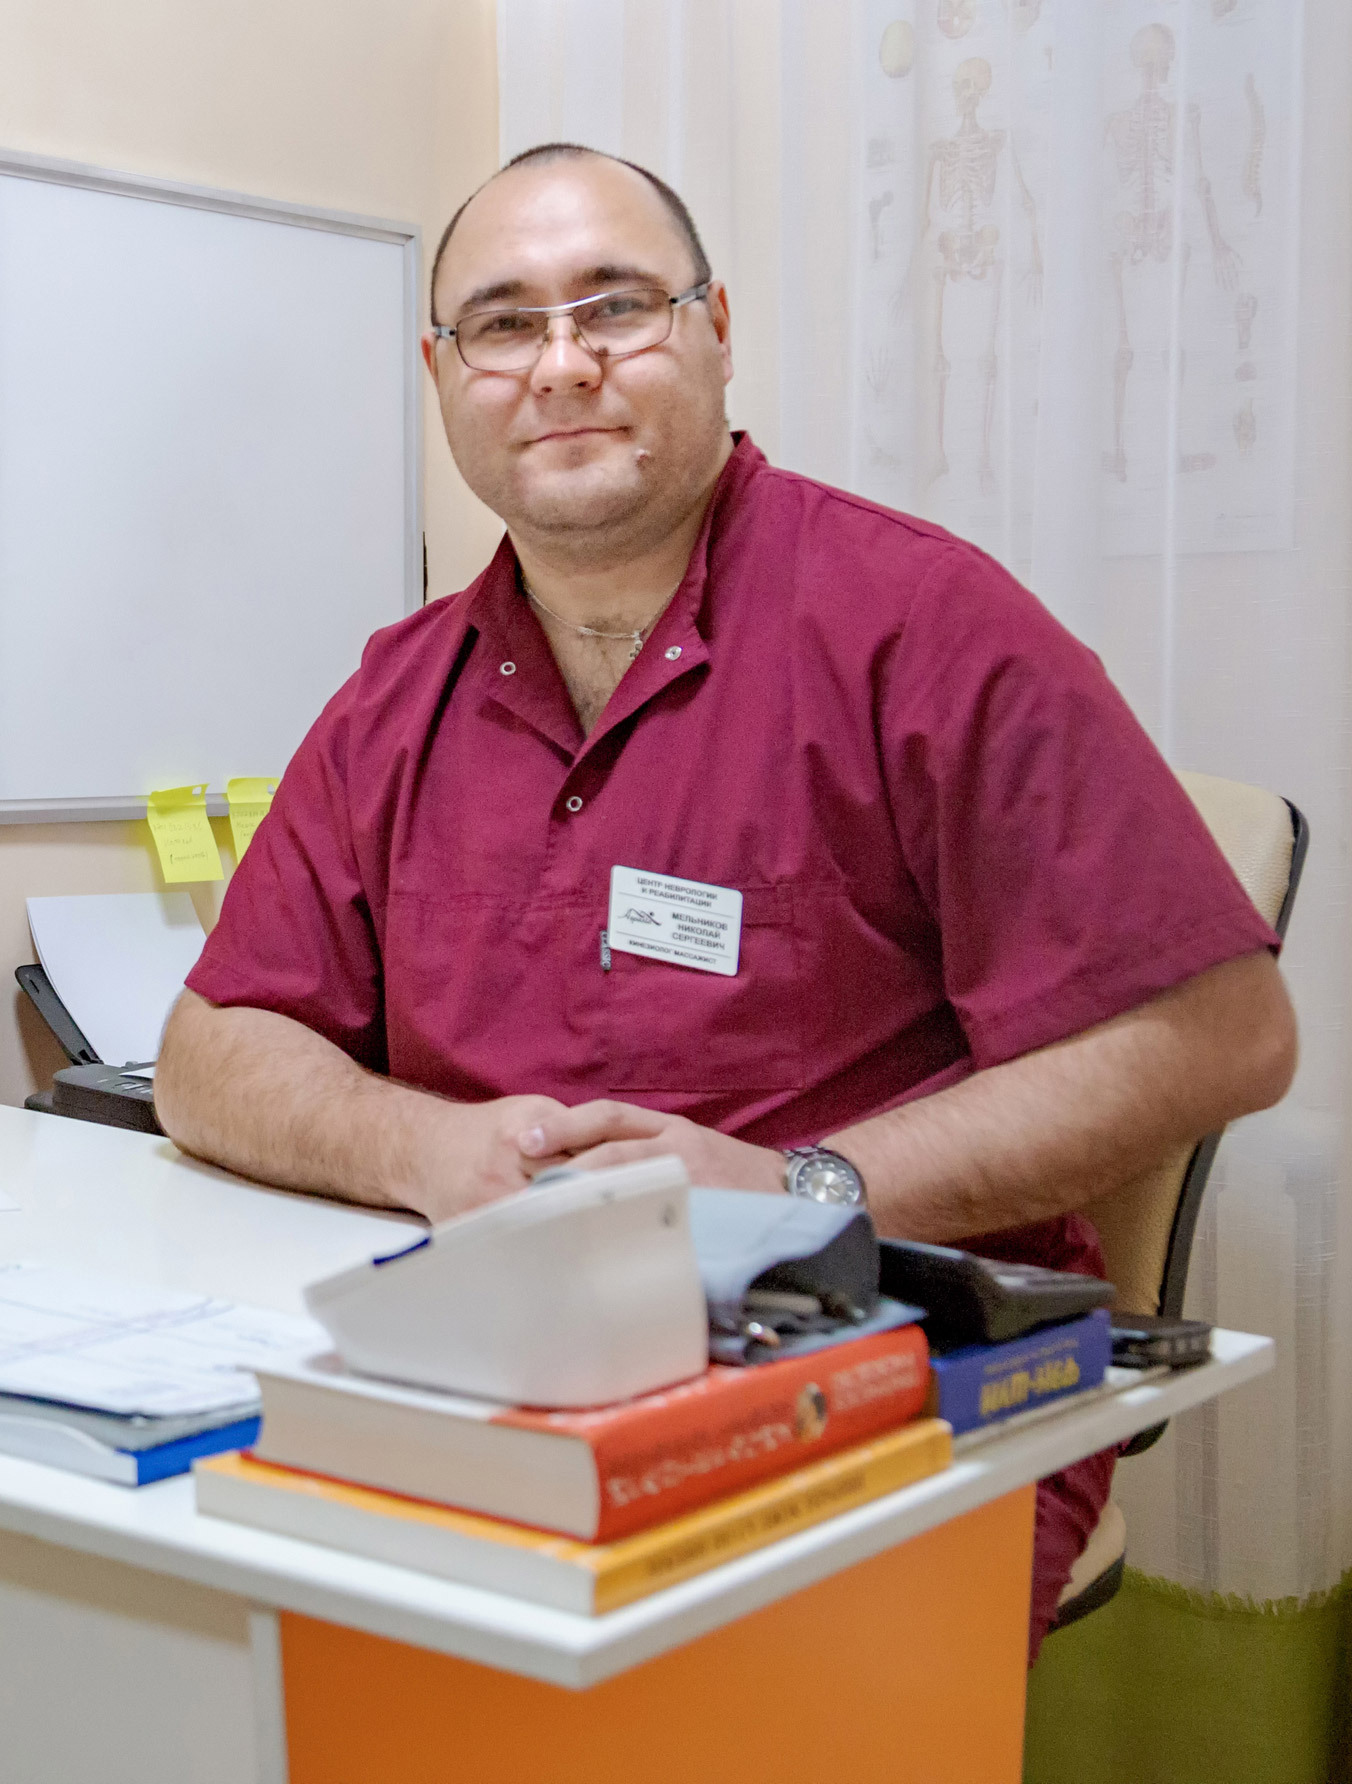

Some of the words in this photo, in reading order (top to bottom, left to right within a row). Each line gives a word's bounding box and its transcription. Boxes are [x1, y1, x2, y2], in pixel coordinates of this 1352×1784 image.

[637, 877, 663, 888] ЦЕНТР
[664, 883, 718, 900] НЕВРОЛОГИИ
[648, 888, 712, 908] РЕАБИЛИТАЦИИ
[671, 912, 728, 931] МЕЛЬНИКОВ
[671, 932, 726, 950] СЕРГЕЕВИЧ
[677, 923, 721, 940] НИКОЛАЙ
[628, 939, 671, 954] КИНЕЗИОЛОГ
[674, 950, 717, 965] МАССАЖИСТ
